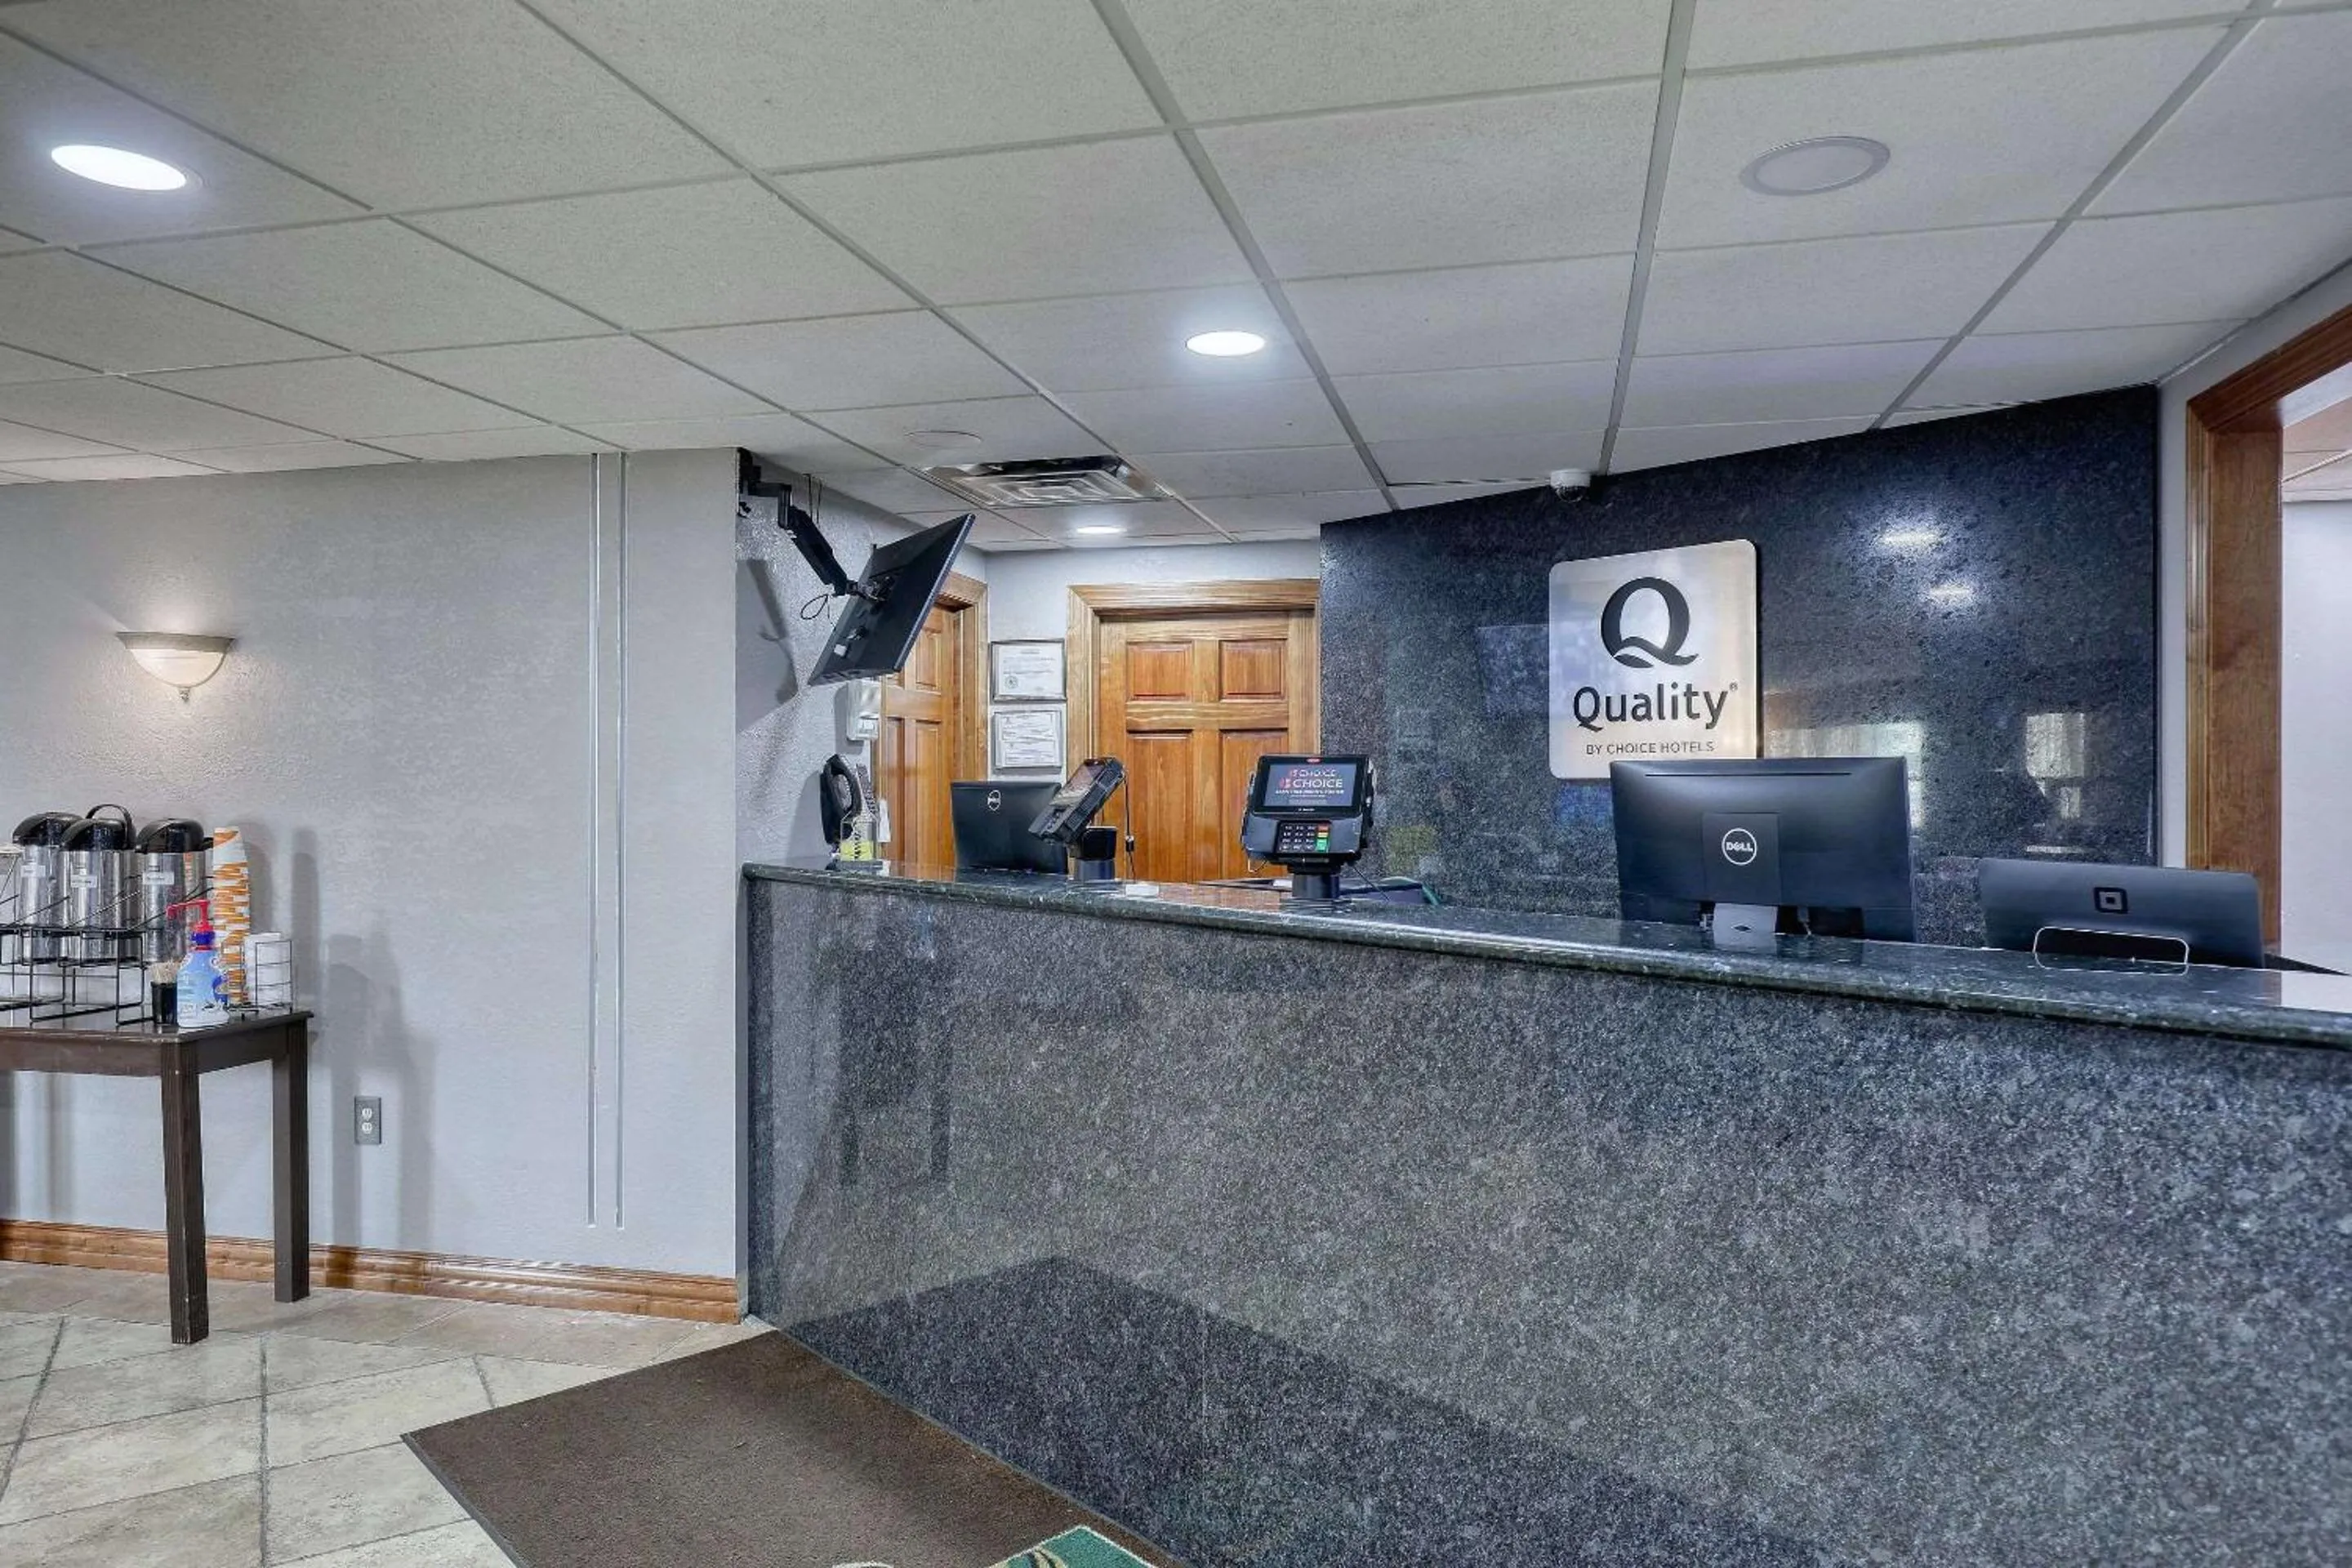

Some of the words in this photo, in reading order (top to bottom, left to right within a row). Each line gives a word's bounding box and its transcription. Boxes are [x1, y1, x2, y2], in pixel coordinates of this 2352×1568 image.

[1586, 744, 1603, 755] BY
[1606, 742, 1657, 755] CHOICE
[1659, 740, 1715, 753] HOTELS
[1293, 778, 1343, 788] CHOICE
[1726, 841, 1753, 852] DELL
